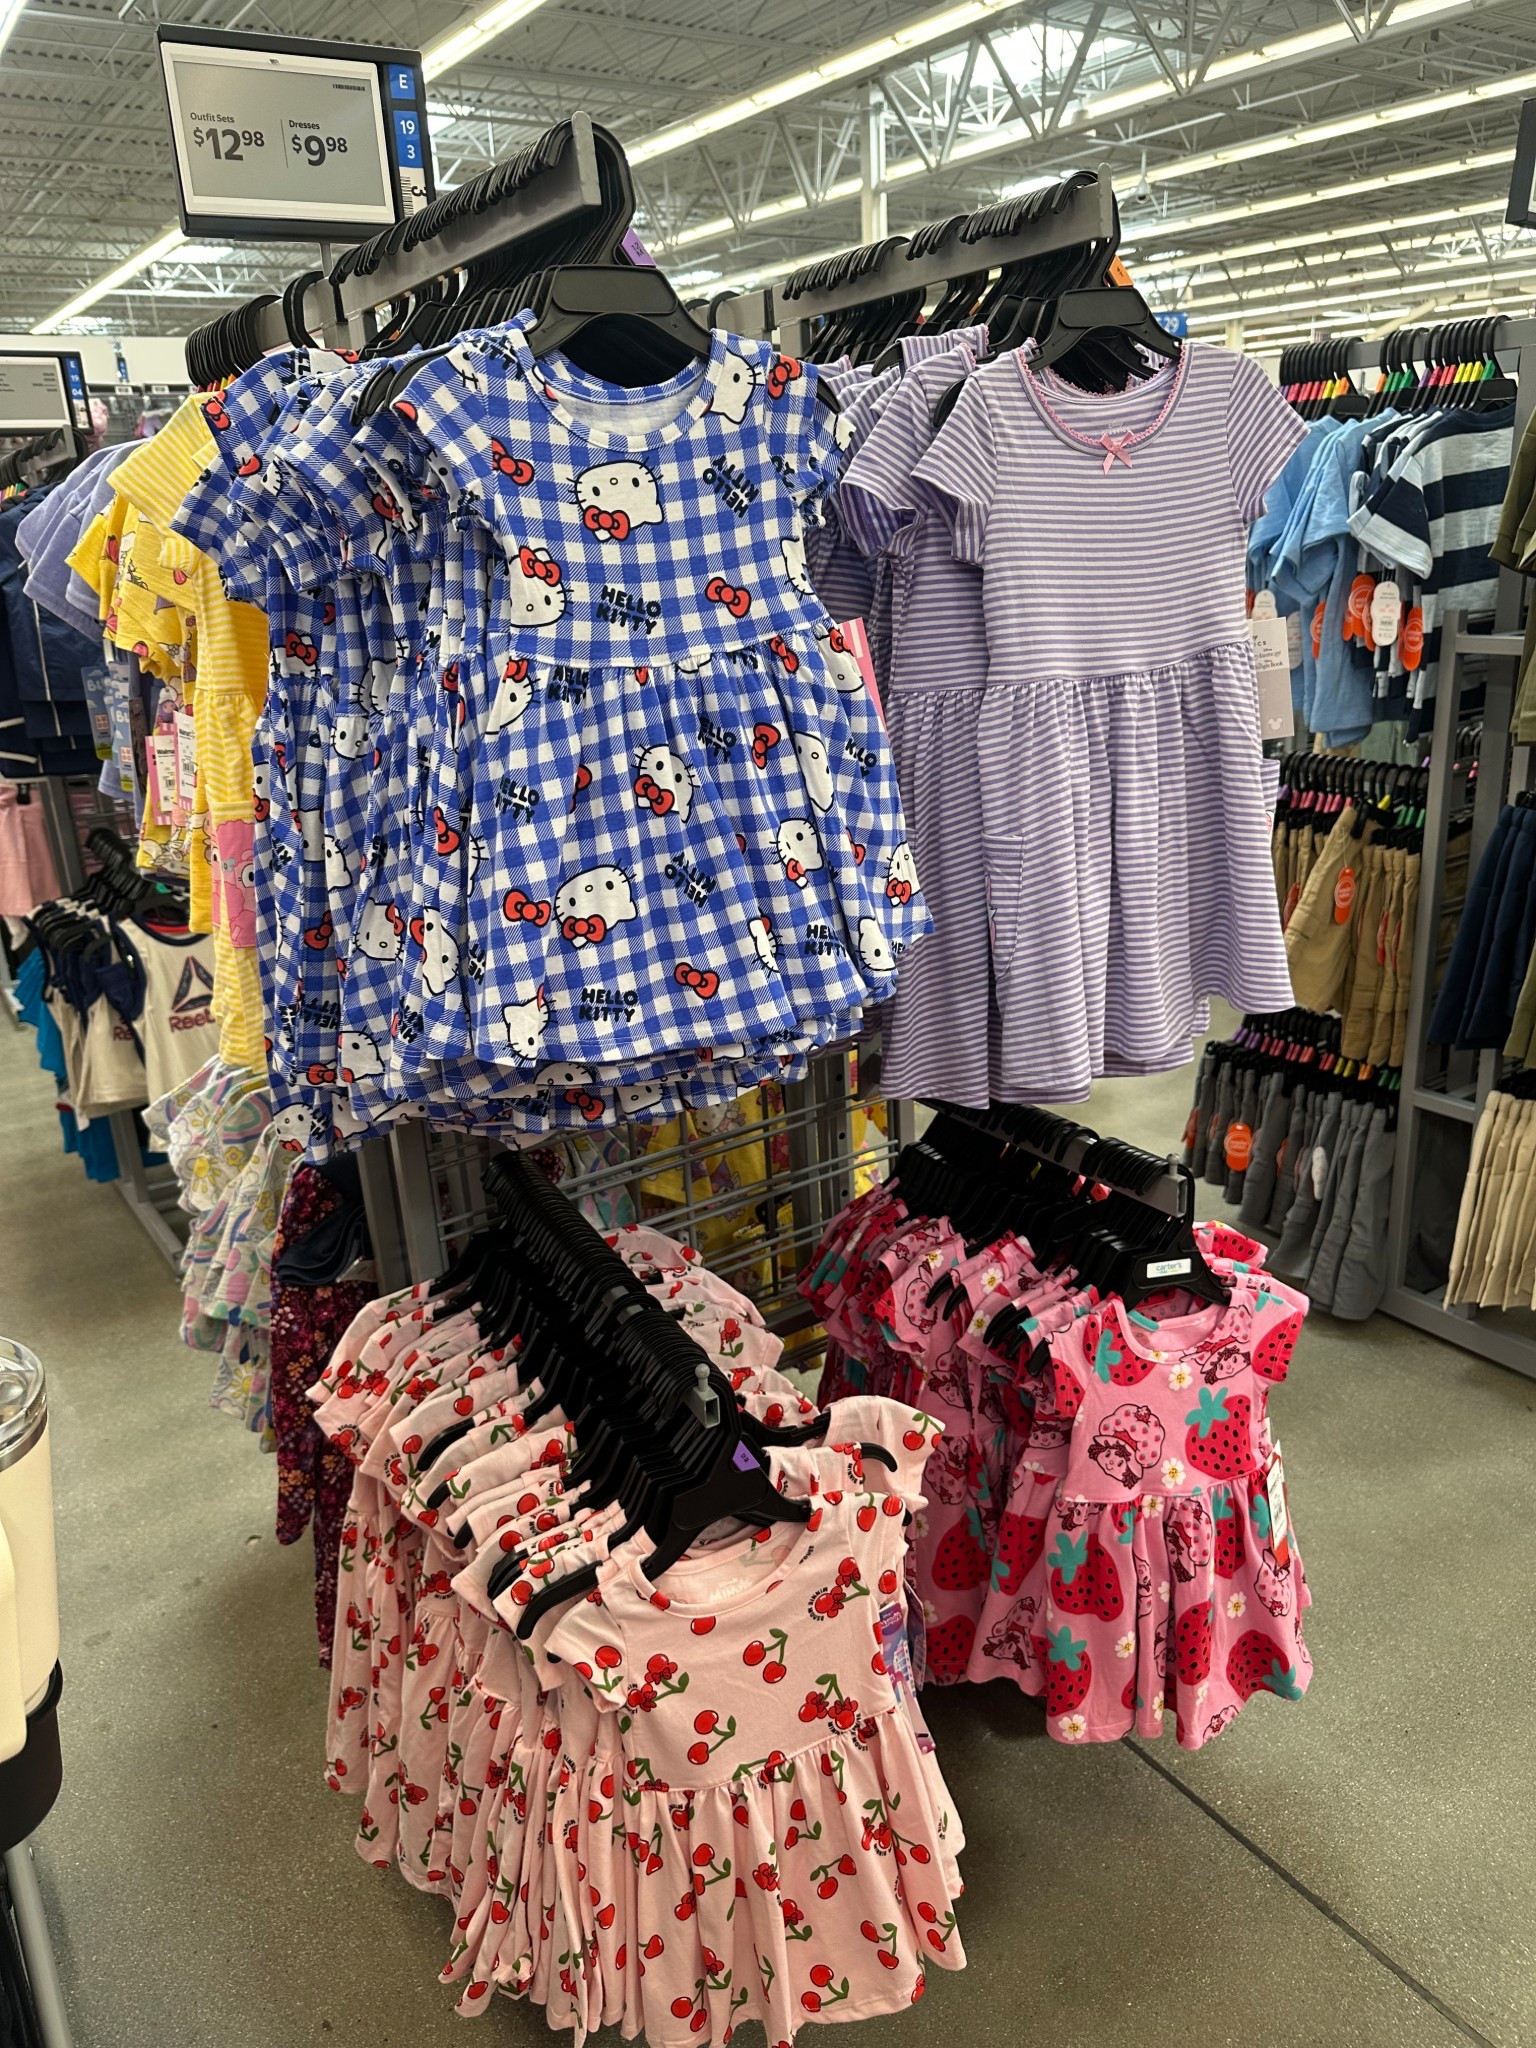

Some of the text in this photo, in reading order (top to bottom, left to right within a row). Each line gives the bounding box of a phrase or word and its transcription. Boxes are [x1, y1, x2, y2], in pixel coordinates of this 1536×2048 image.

[399, 74, 408, 89] E
[190, 112, 235, 123] Outfit Sets
[289, 120, 320, 130] Dresses
[400, 120, 415, 135] 19
[407, 144, 415, 159] 3
[712, 455, 760, 502] KITTY
[703, 468, 749, 518] HELLO
[601, 585, 662, 617] HELLO
[596, 603, 657, 635] KITTY
[581, 988, 638, 1006] HELLO
[579, 1005, 635, 1022] KITTY
[1156, 1262, 1182, 1272] carter's
[808, 1586, 828, 1621] MINNIE MOUSE
